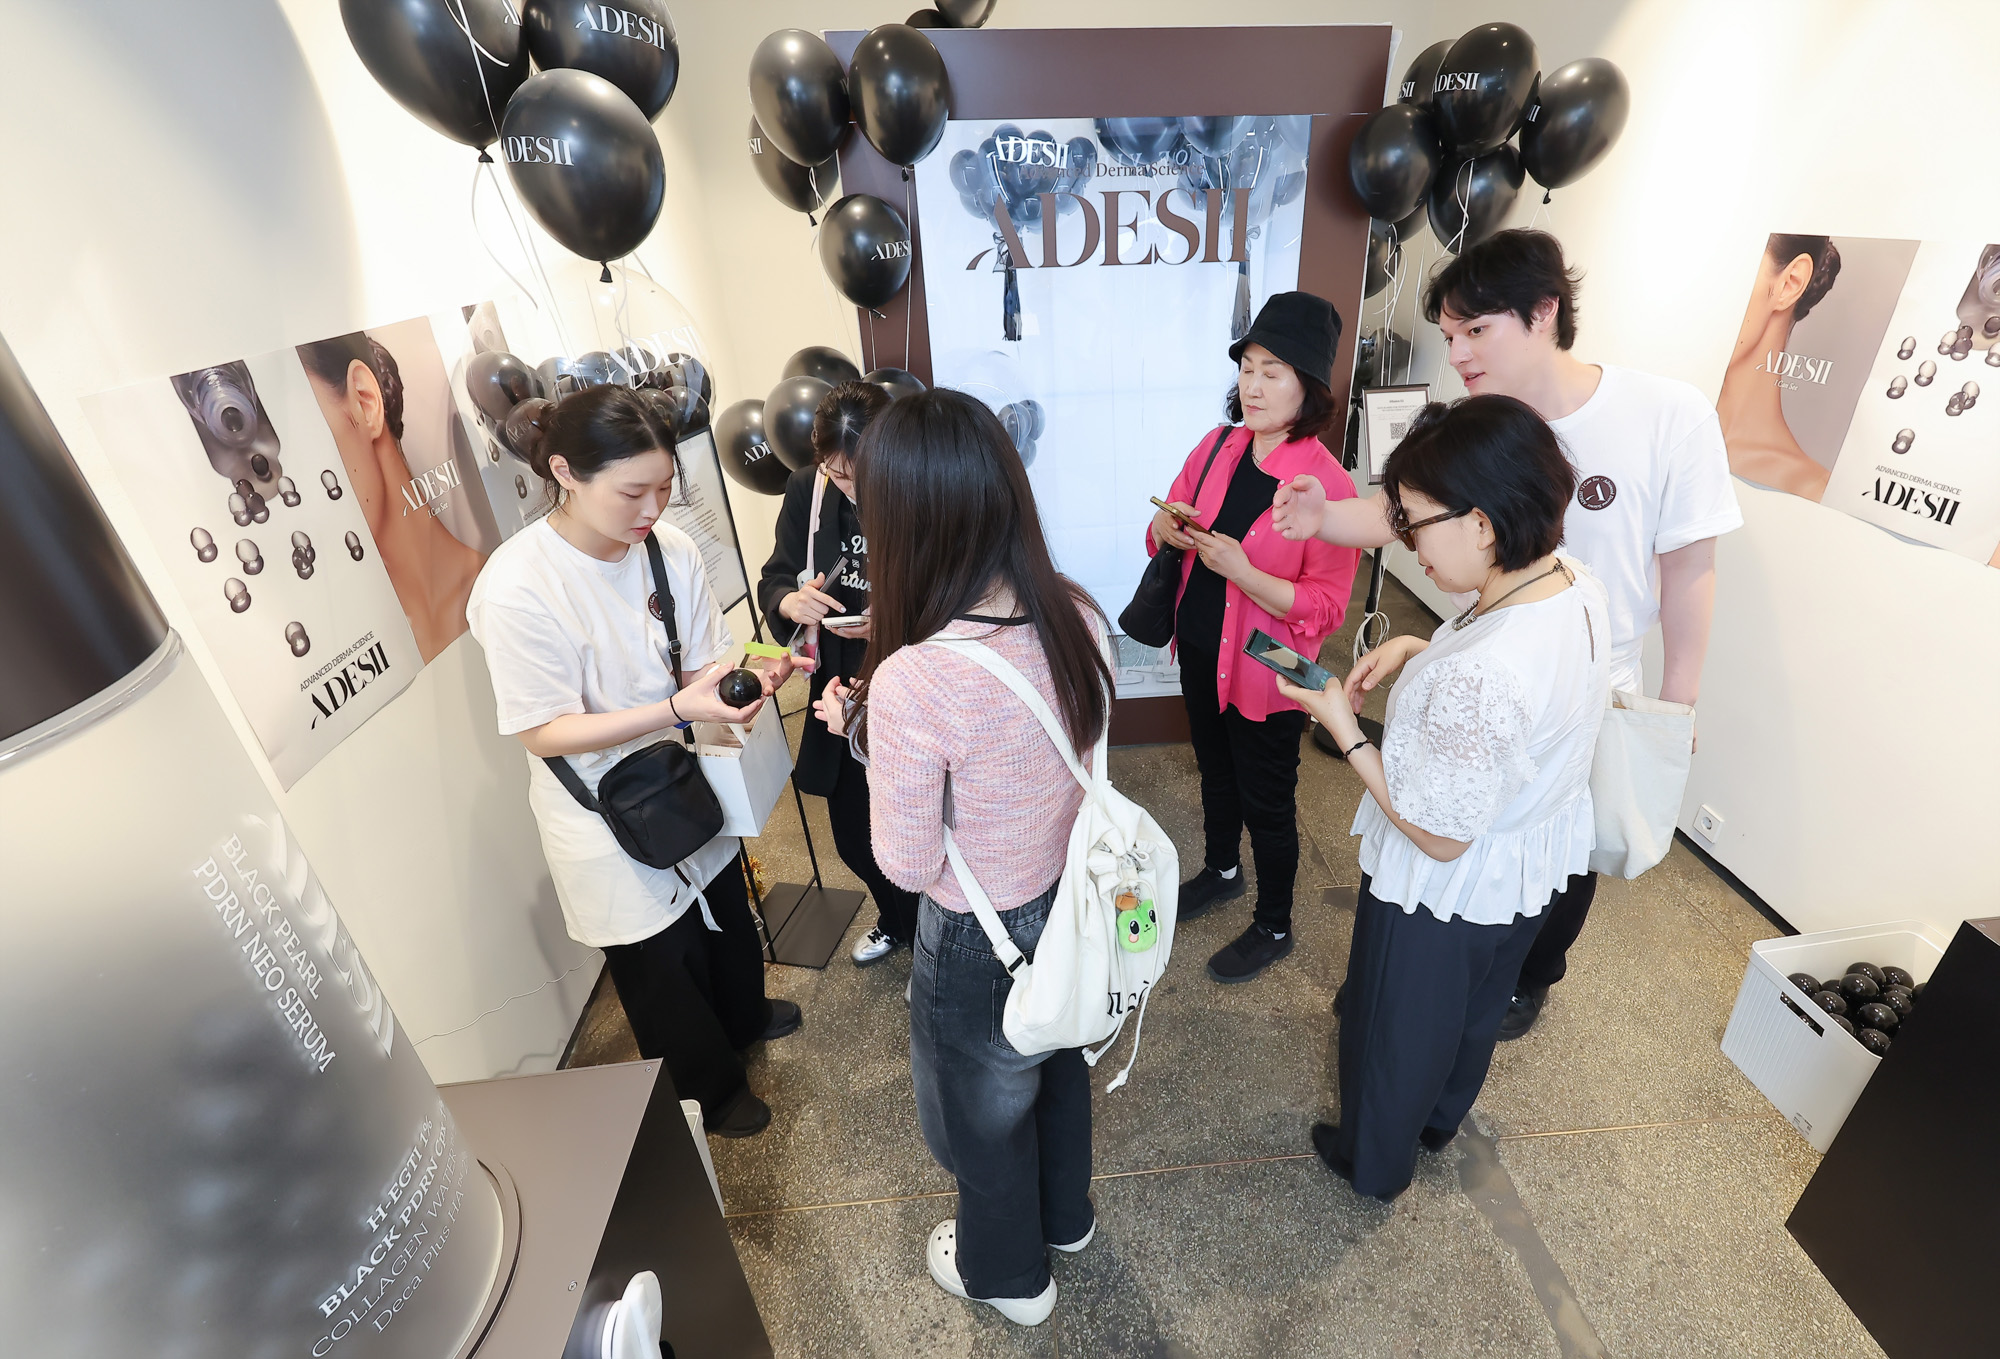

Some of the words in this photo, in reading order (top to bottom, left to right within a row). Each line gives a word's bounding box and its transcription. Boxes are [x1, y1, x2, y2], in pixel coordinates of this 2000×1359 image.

[575, 3, 666, 51] ADESII
[986, 134, 1070, 170] ADESII
[1096, 162, 1146, 178] Derma
[1149, 161, 1205, 176] Science
[965, 186, 1256, 271] ADESII
[1755, 348, 1834, 385] ADESII
[400, 458, 461, 518] ADESII
[439, 501, 449, 513] See
[1861, 475, 1962, 526] ADESII
[1875, 464, 1909, 481] ADVANCED
[1908, 474, 1933, 488] DERMA
[1932, 481, 1962, 496] SCIENCE
[300, 661, 333, 693] ADVANCED
[331, 647, 354, 667] DERMA
[352, 630, 375, 652] SCIENCE
[310, 640, 391, 731] ADESII
[221, 832, 282, 926] BLACK
[273, 916, 324, 1001] PEARL
[192, 855, 254, 939] PDRN
[241, 931, 286, 992] NEO
[277, 986, 337, 1074] SERUM
[365, 1145, 424, 1234] H-EGTI
[419, 1114, 434, 1149] 1%
[311, 1221, 430, 1359] COLLAGEN
[426, 1147, 457, 1218] WATER
[318, 1223, 402, 1320] BLACK
[399, 1155, 439, 1229] PDRN
[371, 1274, 424, 1334] Deca
[420, 1224, 452, 1273] Plus
[447, 1190, 465, 1224] HA
